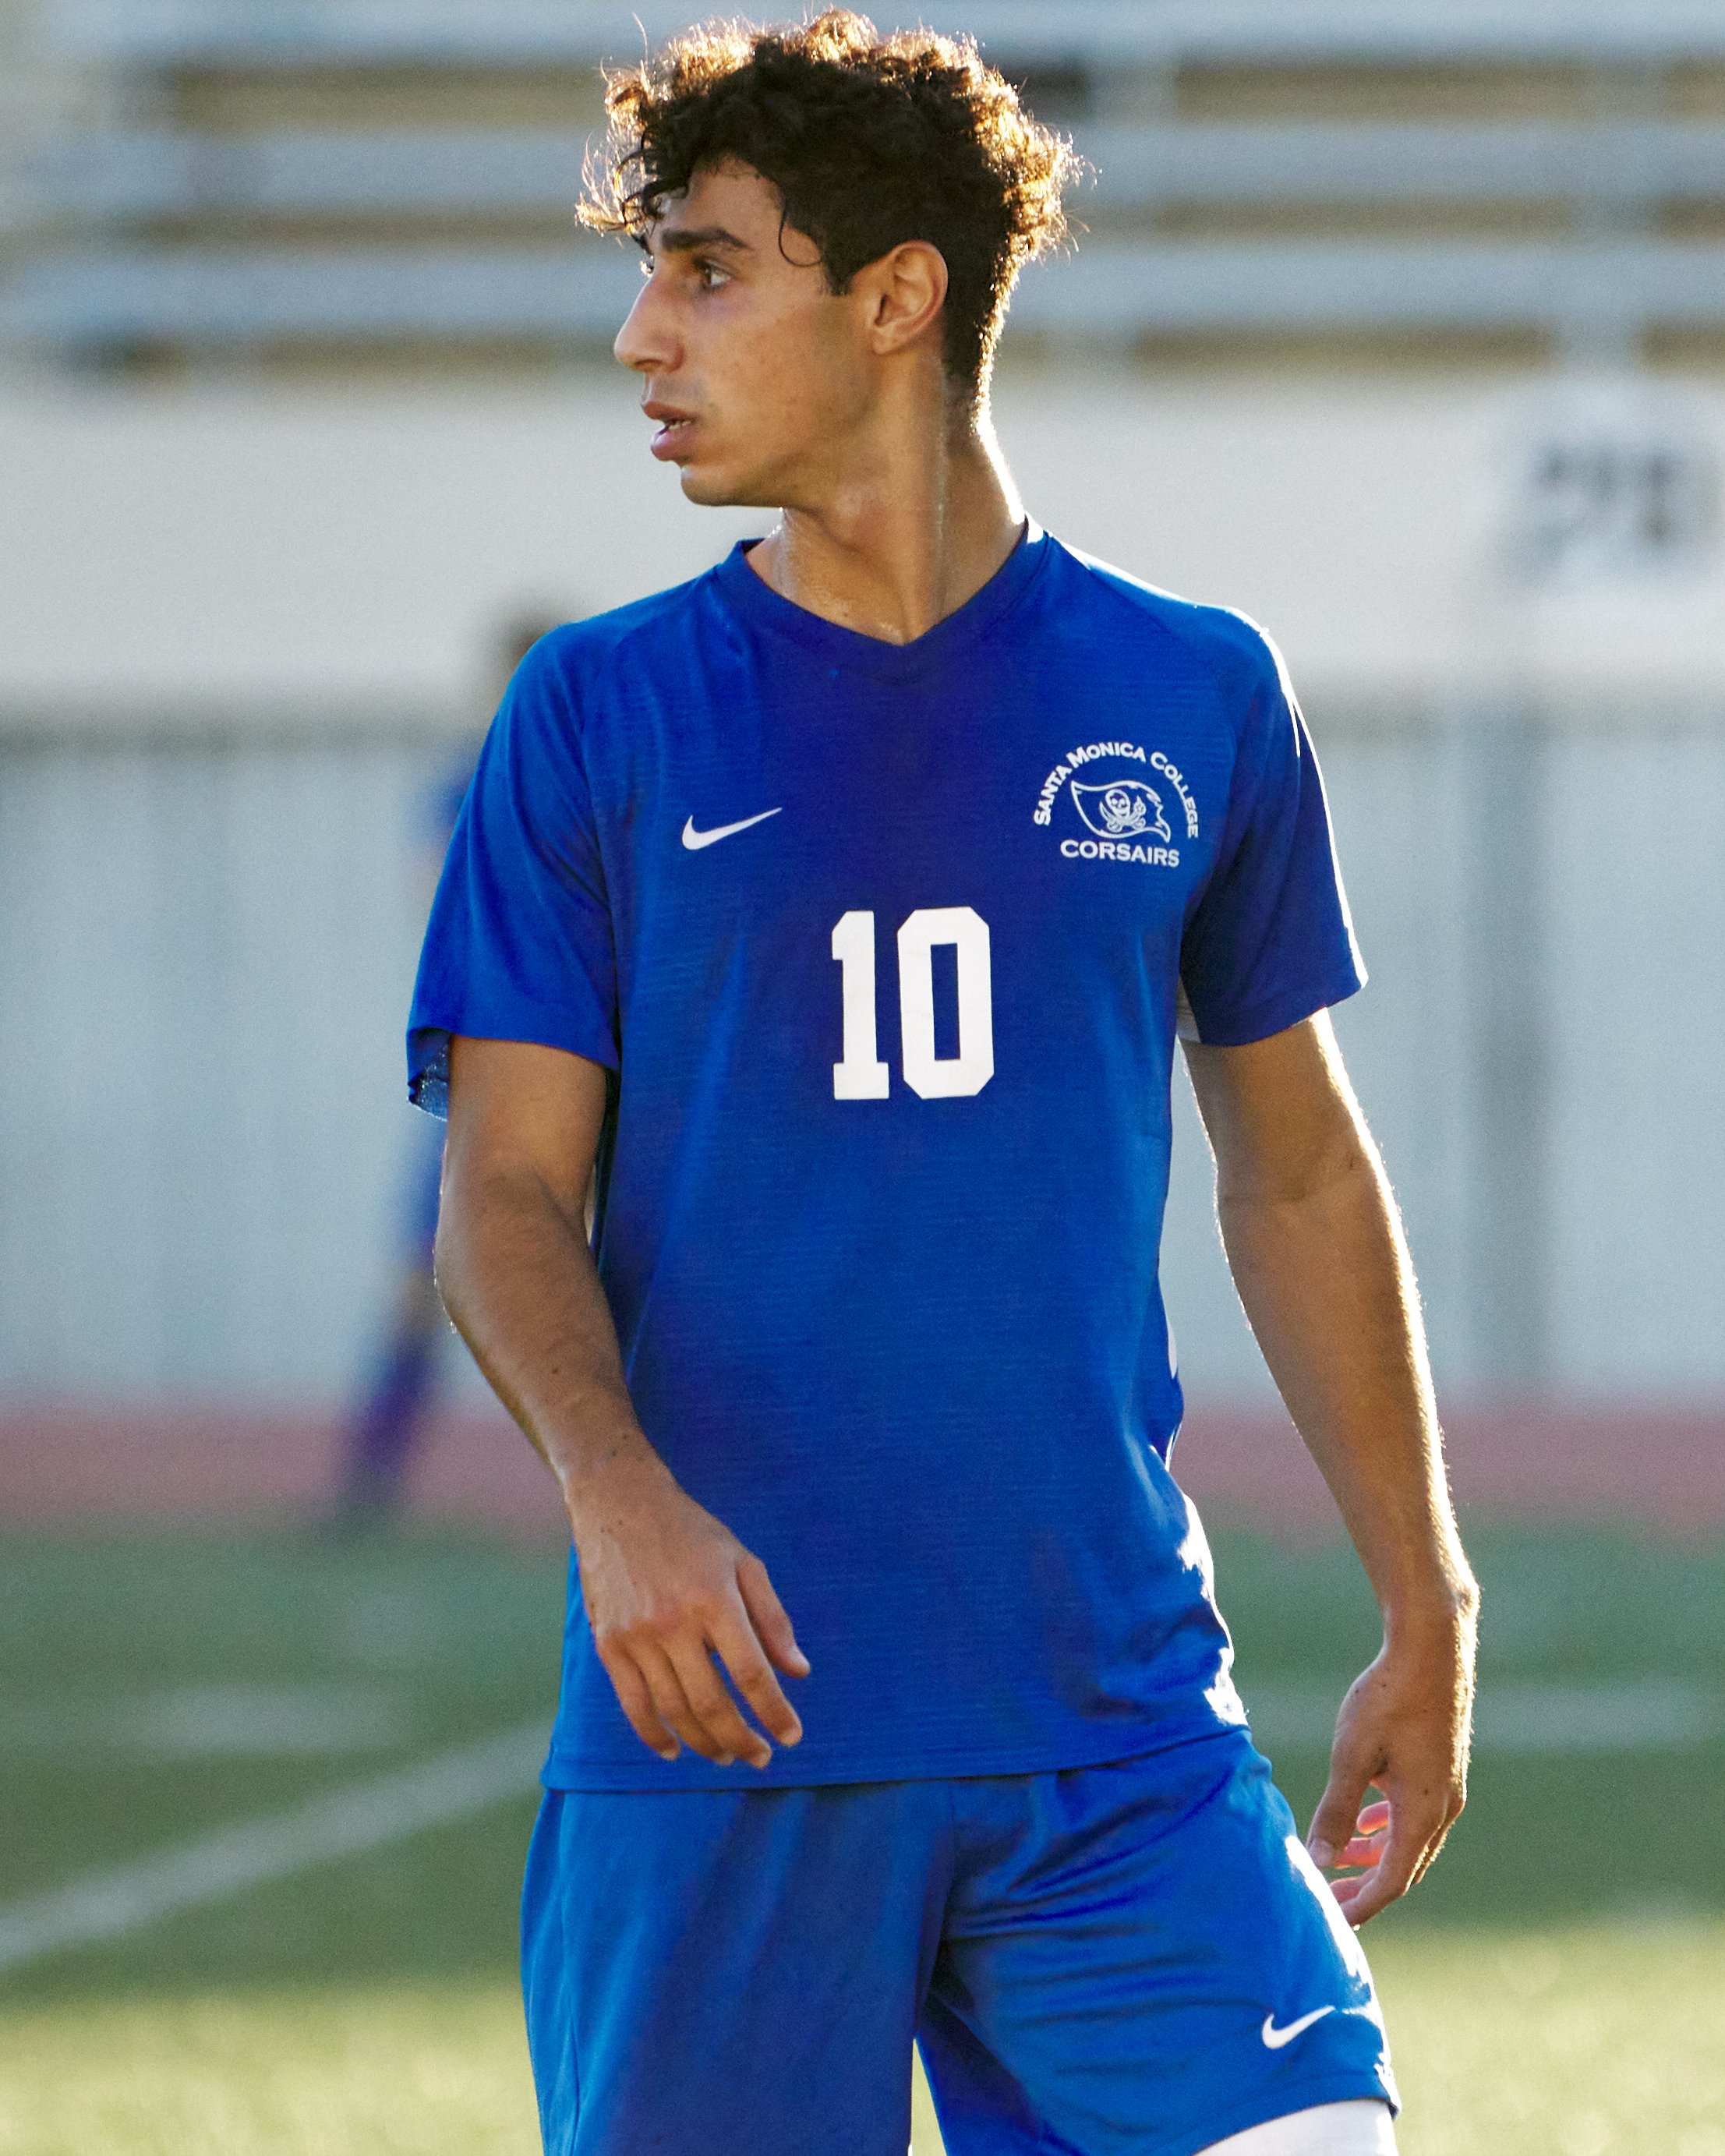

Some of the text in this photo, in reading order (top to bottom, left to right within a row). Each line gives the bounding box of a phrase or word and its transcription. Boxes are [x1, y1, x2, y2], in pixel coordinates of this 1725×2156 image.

[1034, 742, 1198, 839] SANTA MONICA COLLEGE
[1060, 839, 1179, 868] CORSAIRS
[831, 906, 995, 1100] 10
